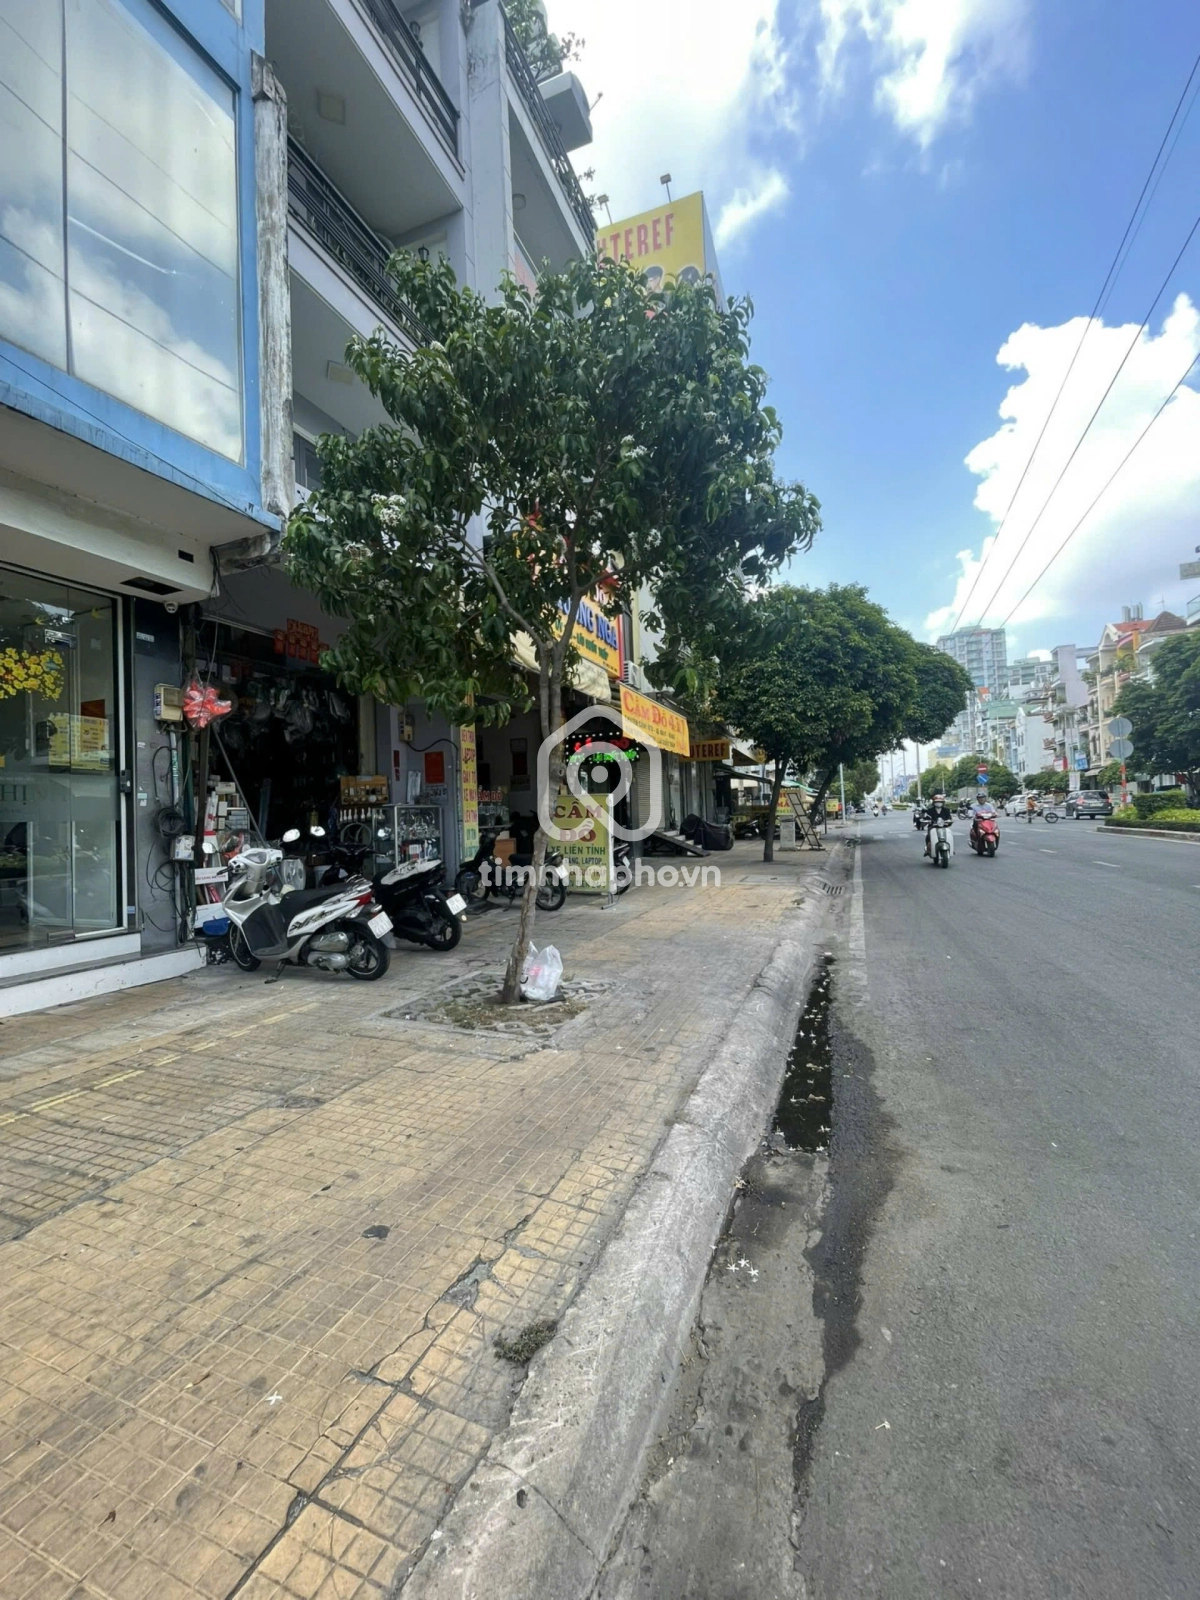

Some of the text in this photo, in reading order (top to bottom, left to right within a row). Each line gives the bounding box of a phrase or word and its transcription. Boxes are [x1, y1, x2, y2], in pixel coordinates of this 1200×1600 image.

[554, 799, 603, 818] CẦM
[559, 820, 597, 842] ĐỒ
[564, 844, 583, 855] LIÊN
[586, 843, 606, 855] TỈNH
